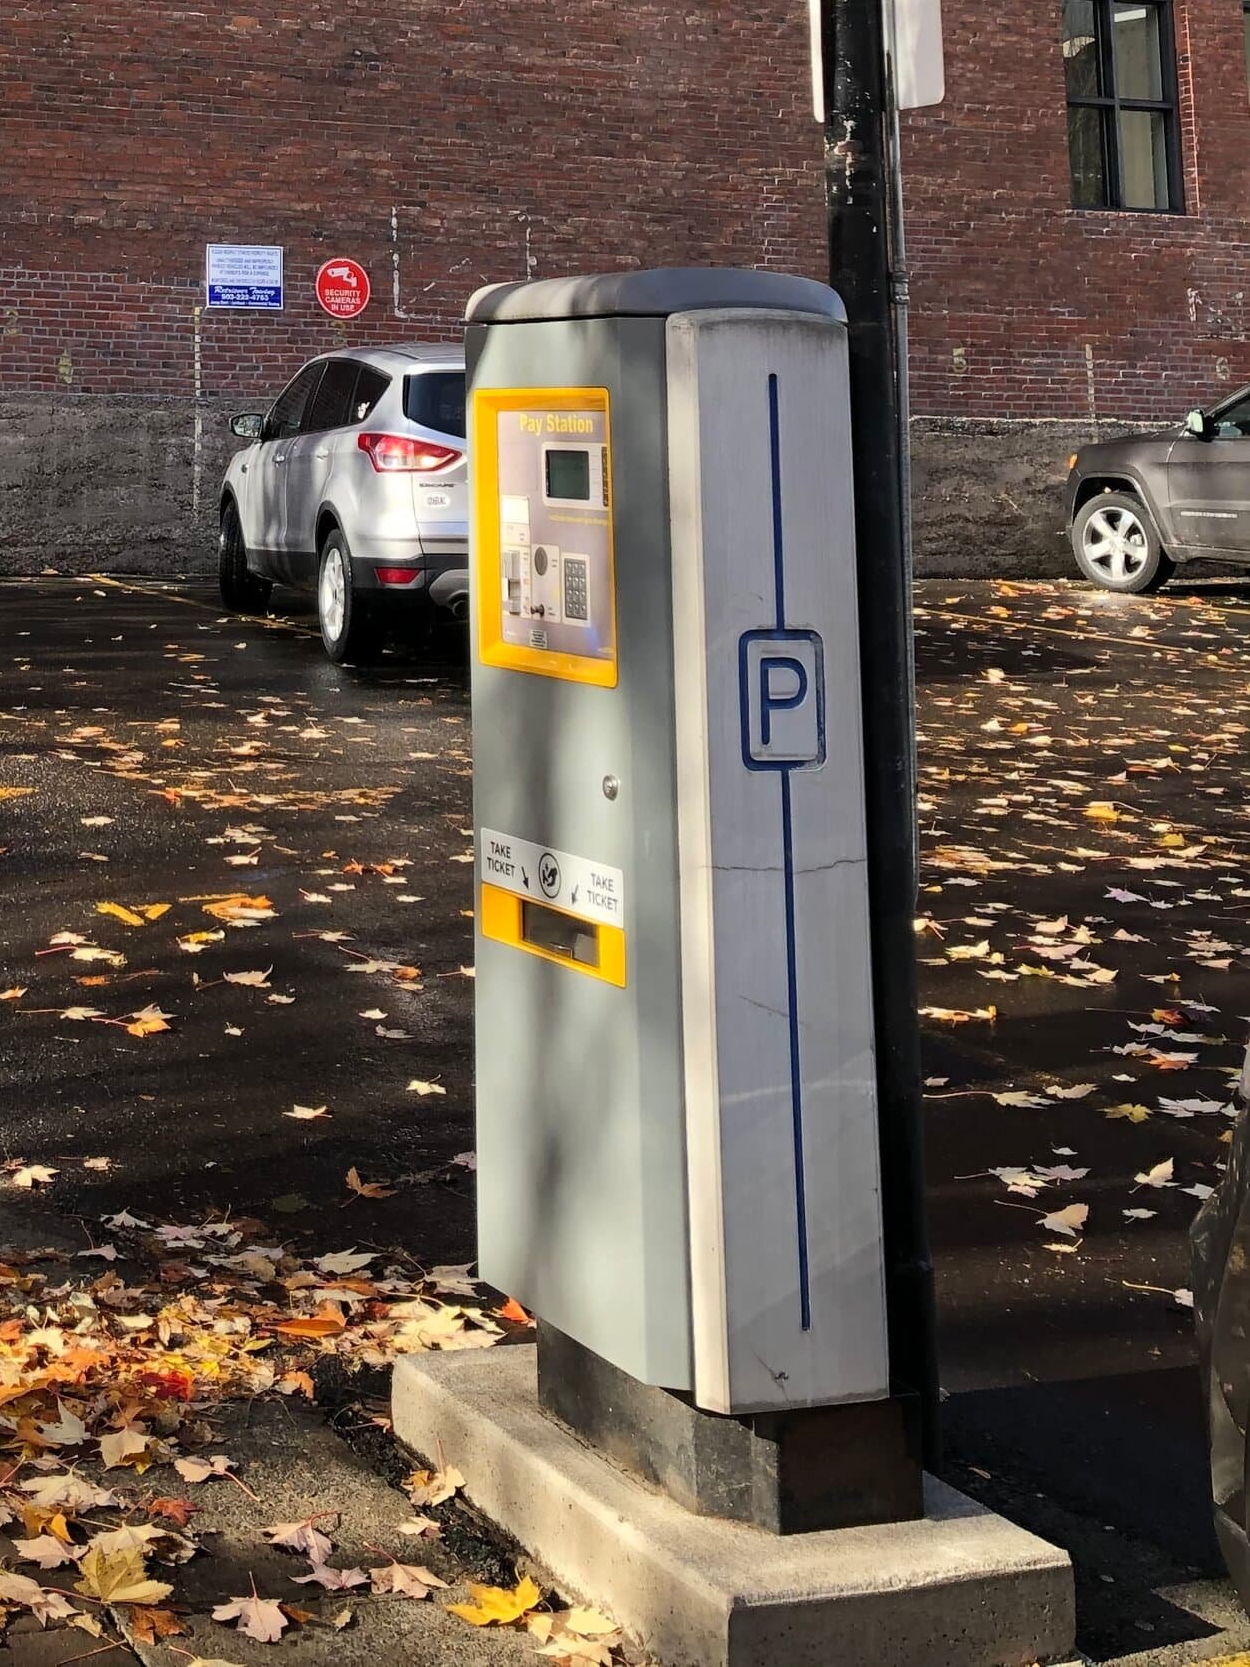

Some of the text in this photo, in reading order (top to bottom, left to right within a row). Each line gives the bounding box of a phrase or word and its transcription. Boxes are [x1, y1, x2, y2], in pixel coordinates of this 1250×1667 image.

[324, 289, 361, 297] SECURITY
[325, 296, 361, 304] CAMERAS
[519, 413, 594, 436] Pay Station
[760, 657, 807, 745] P
[490, 841, 511, 859] TAKE
[487, 857, 516, 879] TICKET
[591, 873, 614, 892] TAKE
[586, 890, 618, 913] TICKET
